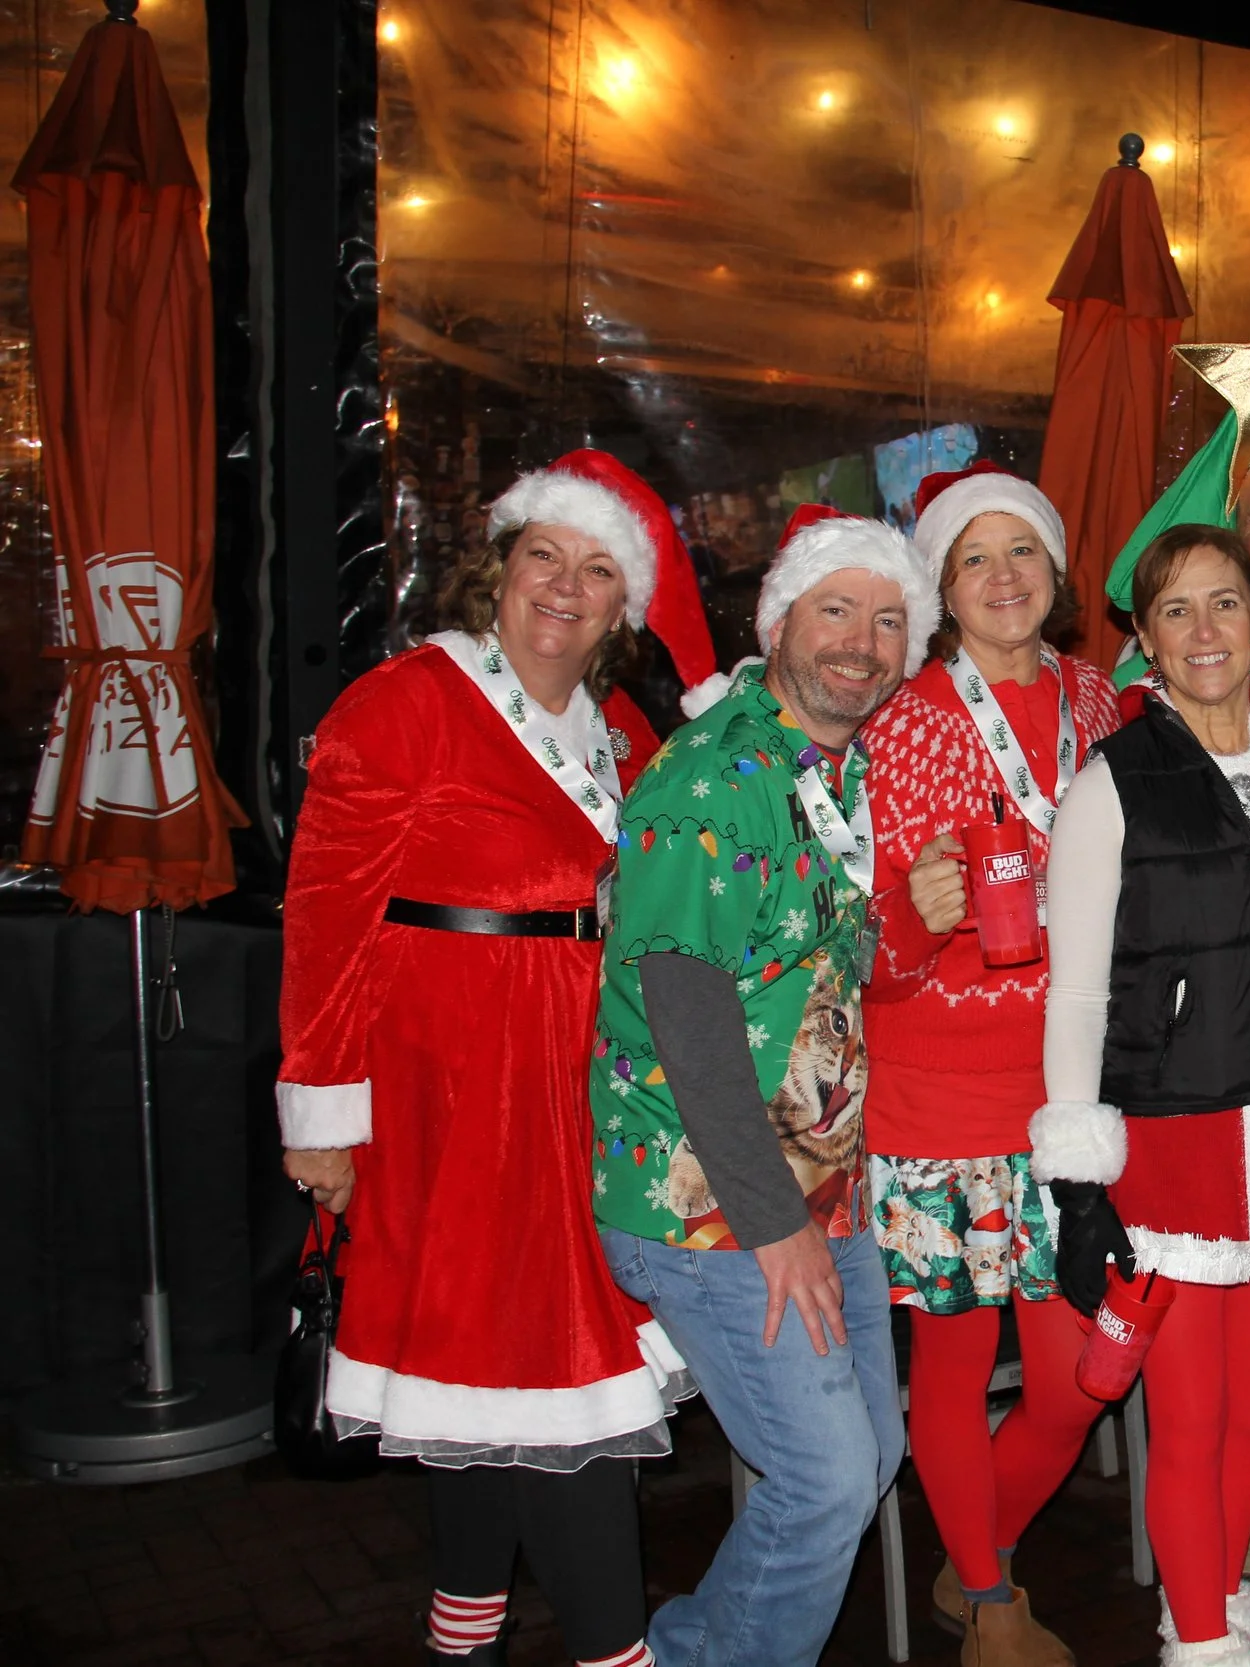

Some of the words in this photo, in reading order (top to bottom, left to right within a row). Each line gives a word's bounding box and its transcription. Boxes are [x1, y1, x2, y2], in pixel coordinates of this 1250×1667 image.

[992, 855, 1023, 870] BUD
[988, 864, 1029, 882] LIGHT
[1102, 1307, 1125, 1331] BUD
